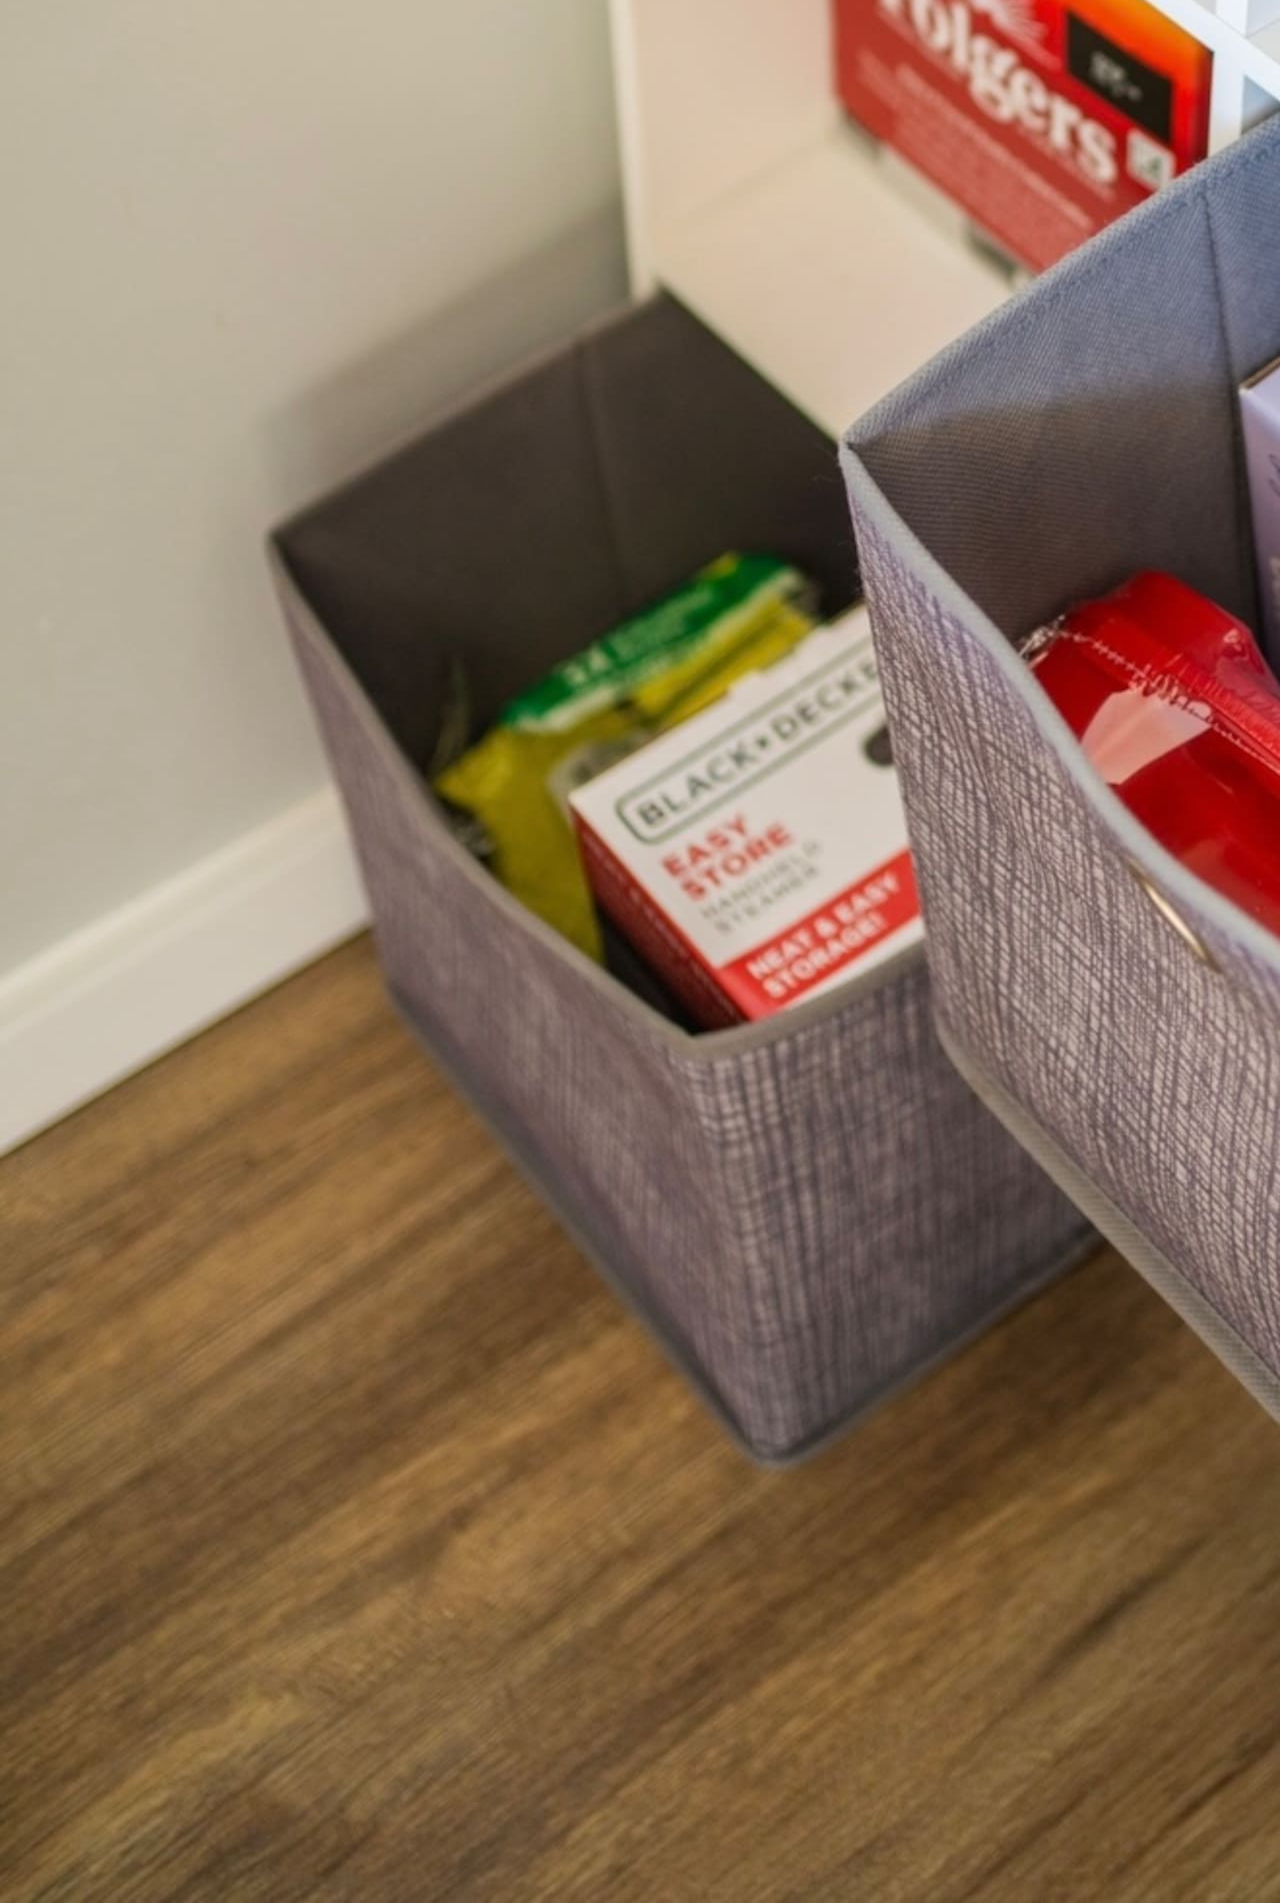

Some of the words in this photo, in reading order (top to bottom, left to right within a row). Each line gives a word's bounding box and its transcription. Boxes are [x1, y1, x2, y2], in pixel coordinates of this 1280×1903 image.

[637, 658, 880, 827] BLACK+DECKE
[661, 813, 748, 878] EASY
[681, 823, 793, 901] STORE
[746, 928, 813, 980] NEAT
[814, 916, 838, 940] &
[833, 870, 899, 925] EASY
[761, 910, 888, 999] STORAGE!
